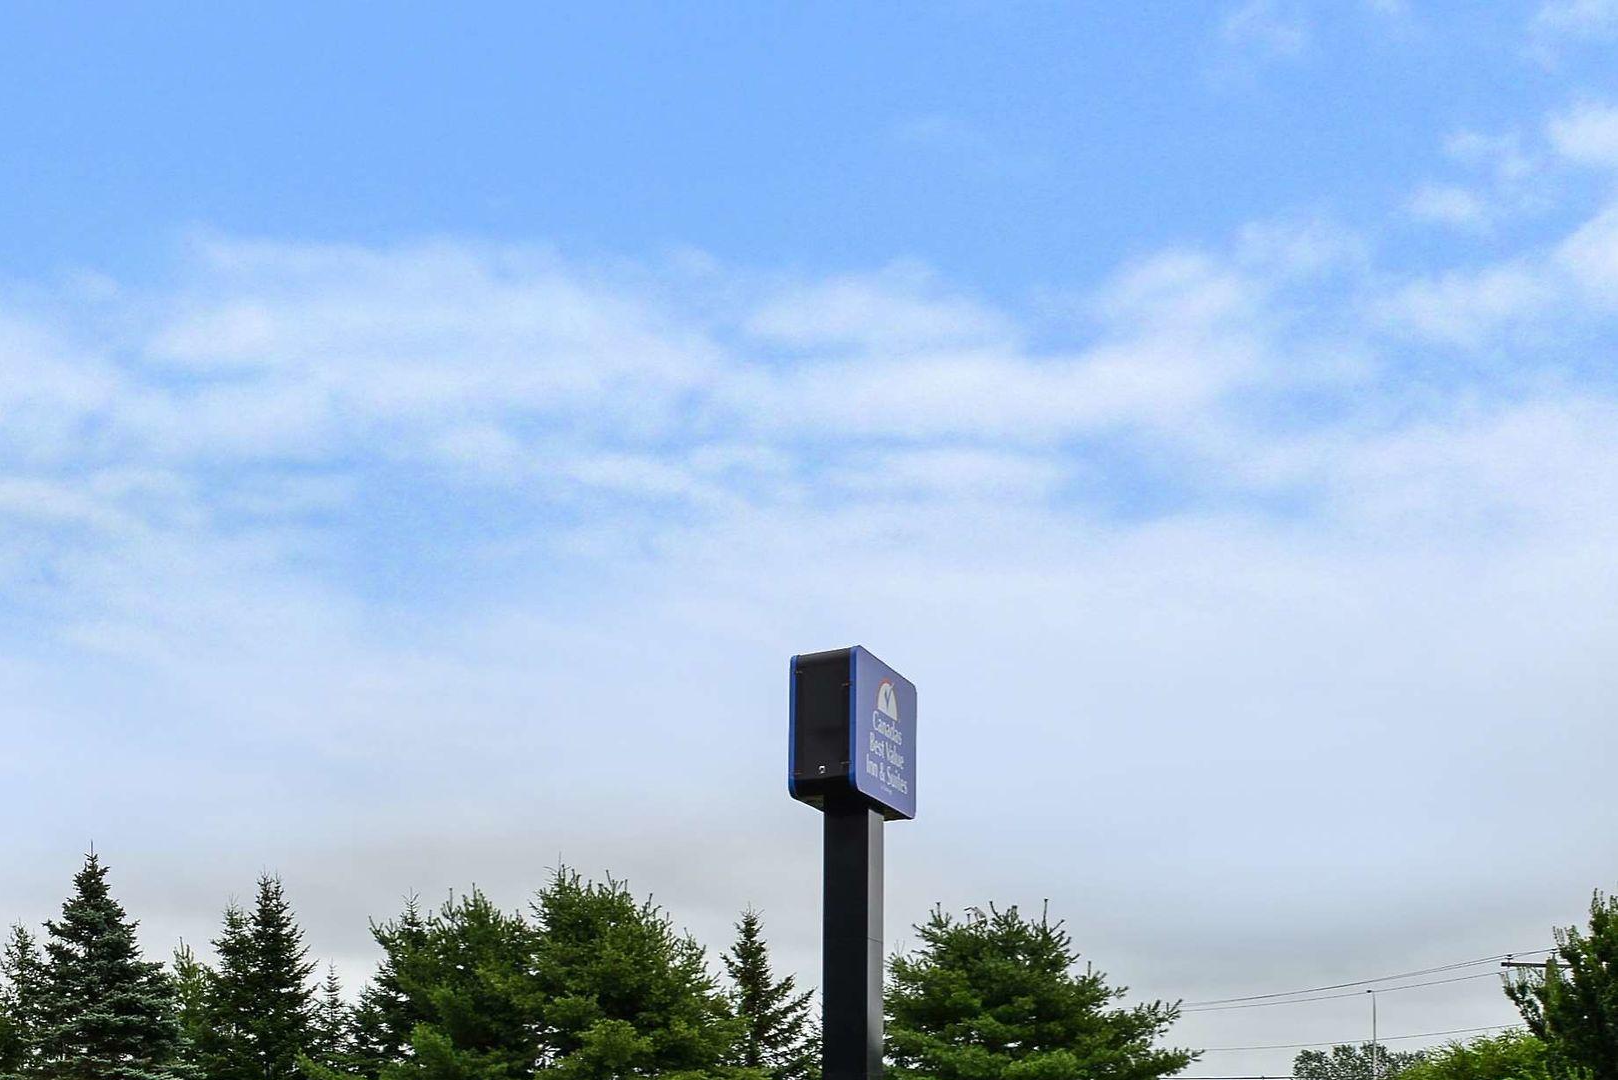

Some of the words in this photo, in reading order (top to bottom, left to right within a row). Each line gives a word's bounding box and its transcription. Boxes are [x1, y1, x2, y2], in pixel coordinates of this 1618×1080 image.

[870, 731, 885, 759] Best
[885, 742, 904, 770] Value
[866, 753, 878, 778] Inn
[879, 762, 886, 782] &
[886, 766, 908, 795] Suites
